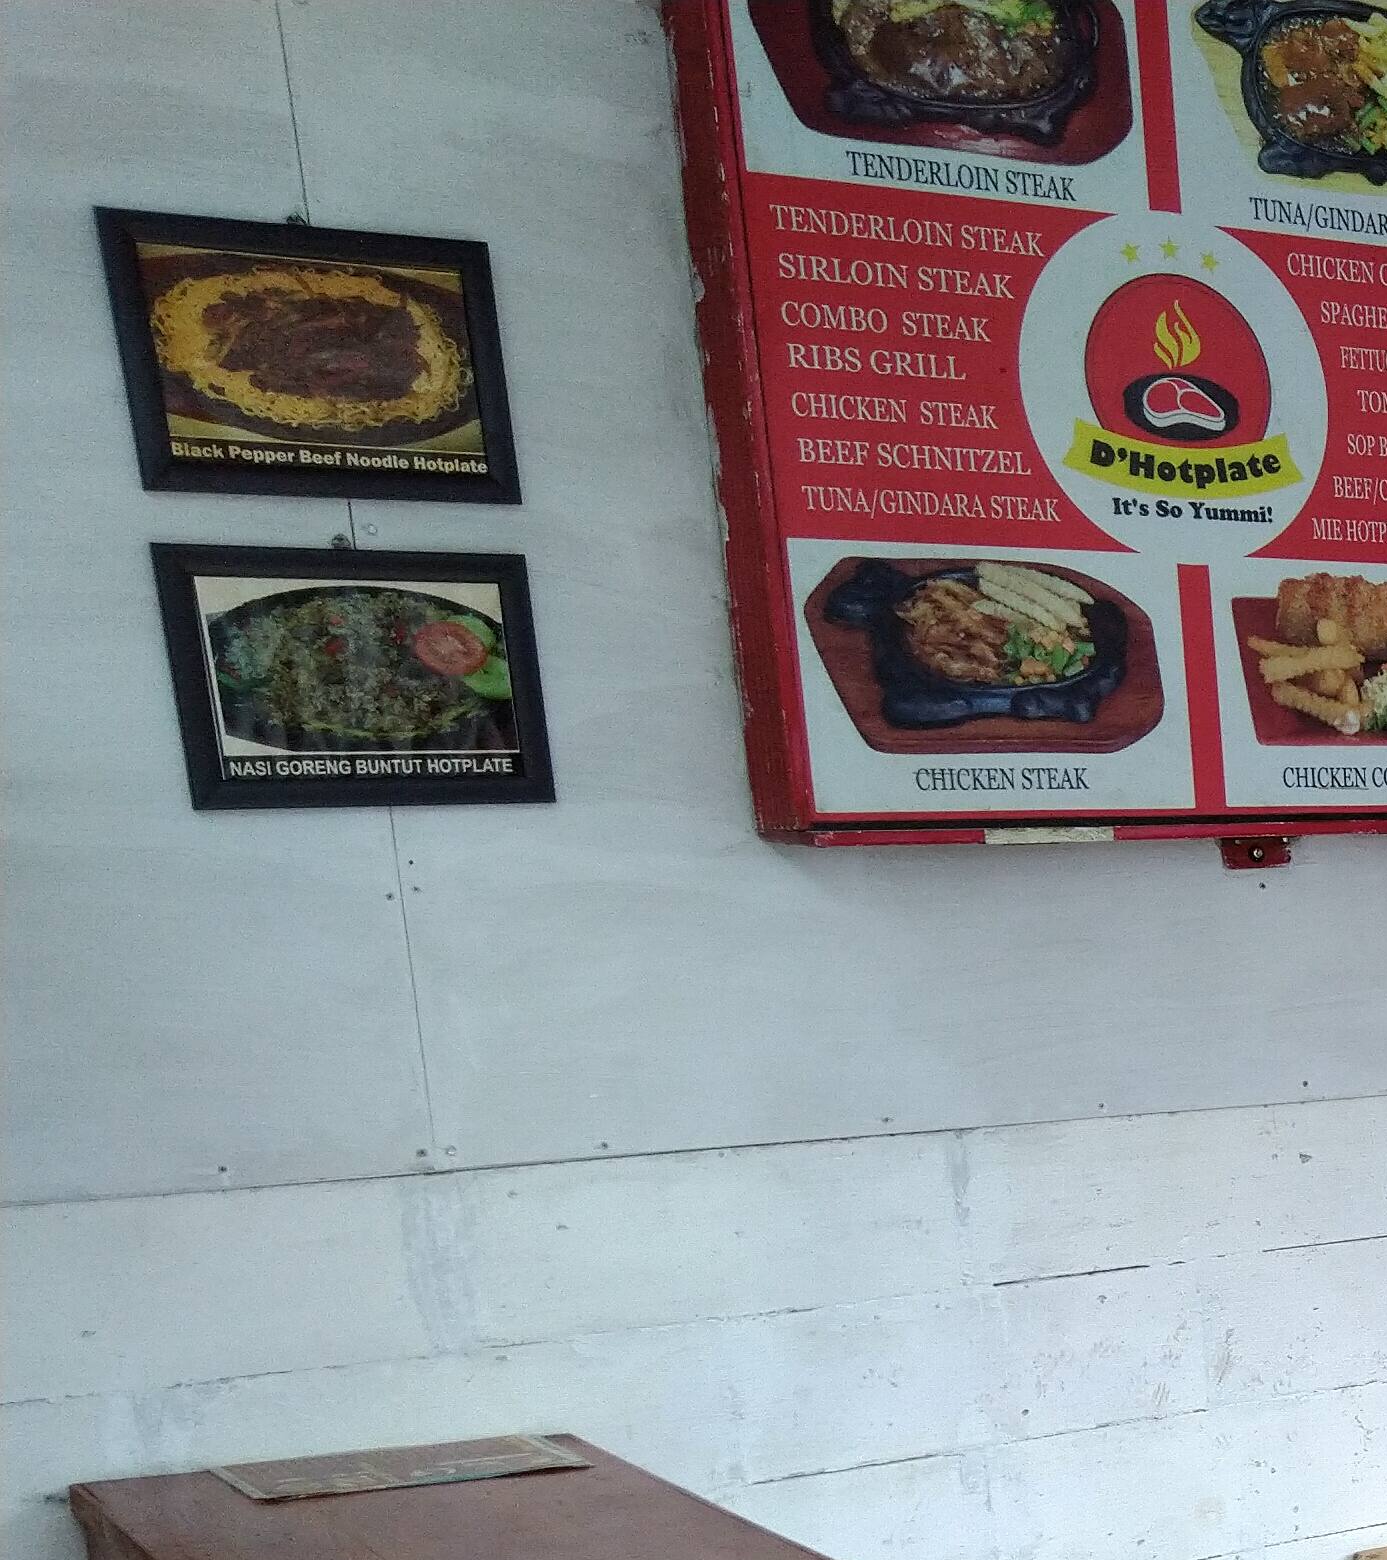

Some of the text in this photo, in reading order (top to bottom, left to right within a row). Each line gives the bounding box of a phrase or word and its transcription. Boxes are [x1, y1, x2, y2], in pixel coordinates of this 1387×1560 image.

[846, 150, 1077, 202] TENDERLOIN STEAK
[769, 204, 1045, 257] TENDERLOIN STEAK
[778, 252, 1014, 299] SIRLOIN STEAK
[1287, 252, 1375, 284] CHICKEN
[781, 301, 992, 342] COMBO STEAK
[786, 343, 966, 380] RIBS GRILL
[791, 391, 998, 430] CHICKEN STEAK
[171, 440, 489, 477] Black Pepper Beef Noodle Hotplate
[797, 437, 1032, 475] BEEF SCHNITZEL
[1347, 433, 1375, 456] SOP
[801, 485, 1062, 522] TUNA/GINDARA STEAK
[1112, 497, 1274, 524] It's So Yummi!
[1311, 517, 1342, 542] MIE
[229, 757, 513, 778] NASI GORENG BUNTUT HOTPLATE
[913, 767, 1089, 791] CHICKEN STEAK
[1282, 766, 1368, 789] CHICKEN
